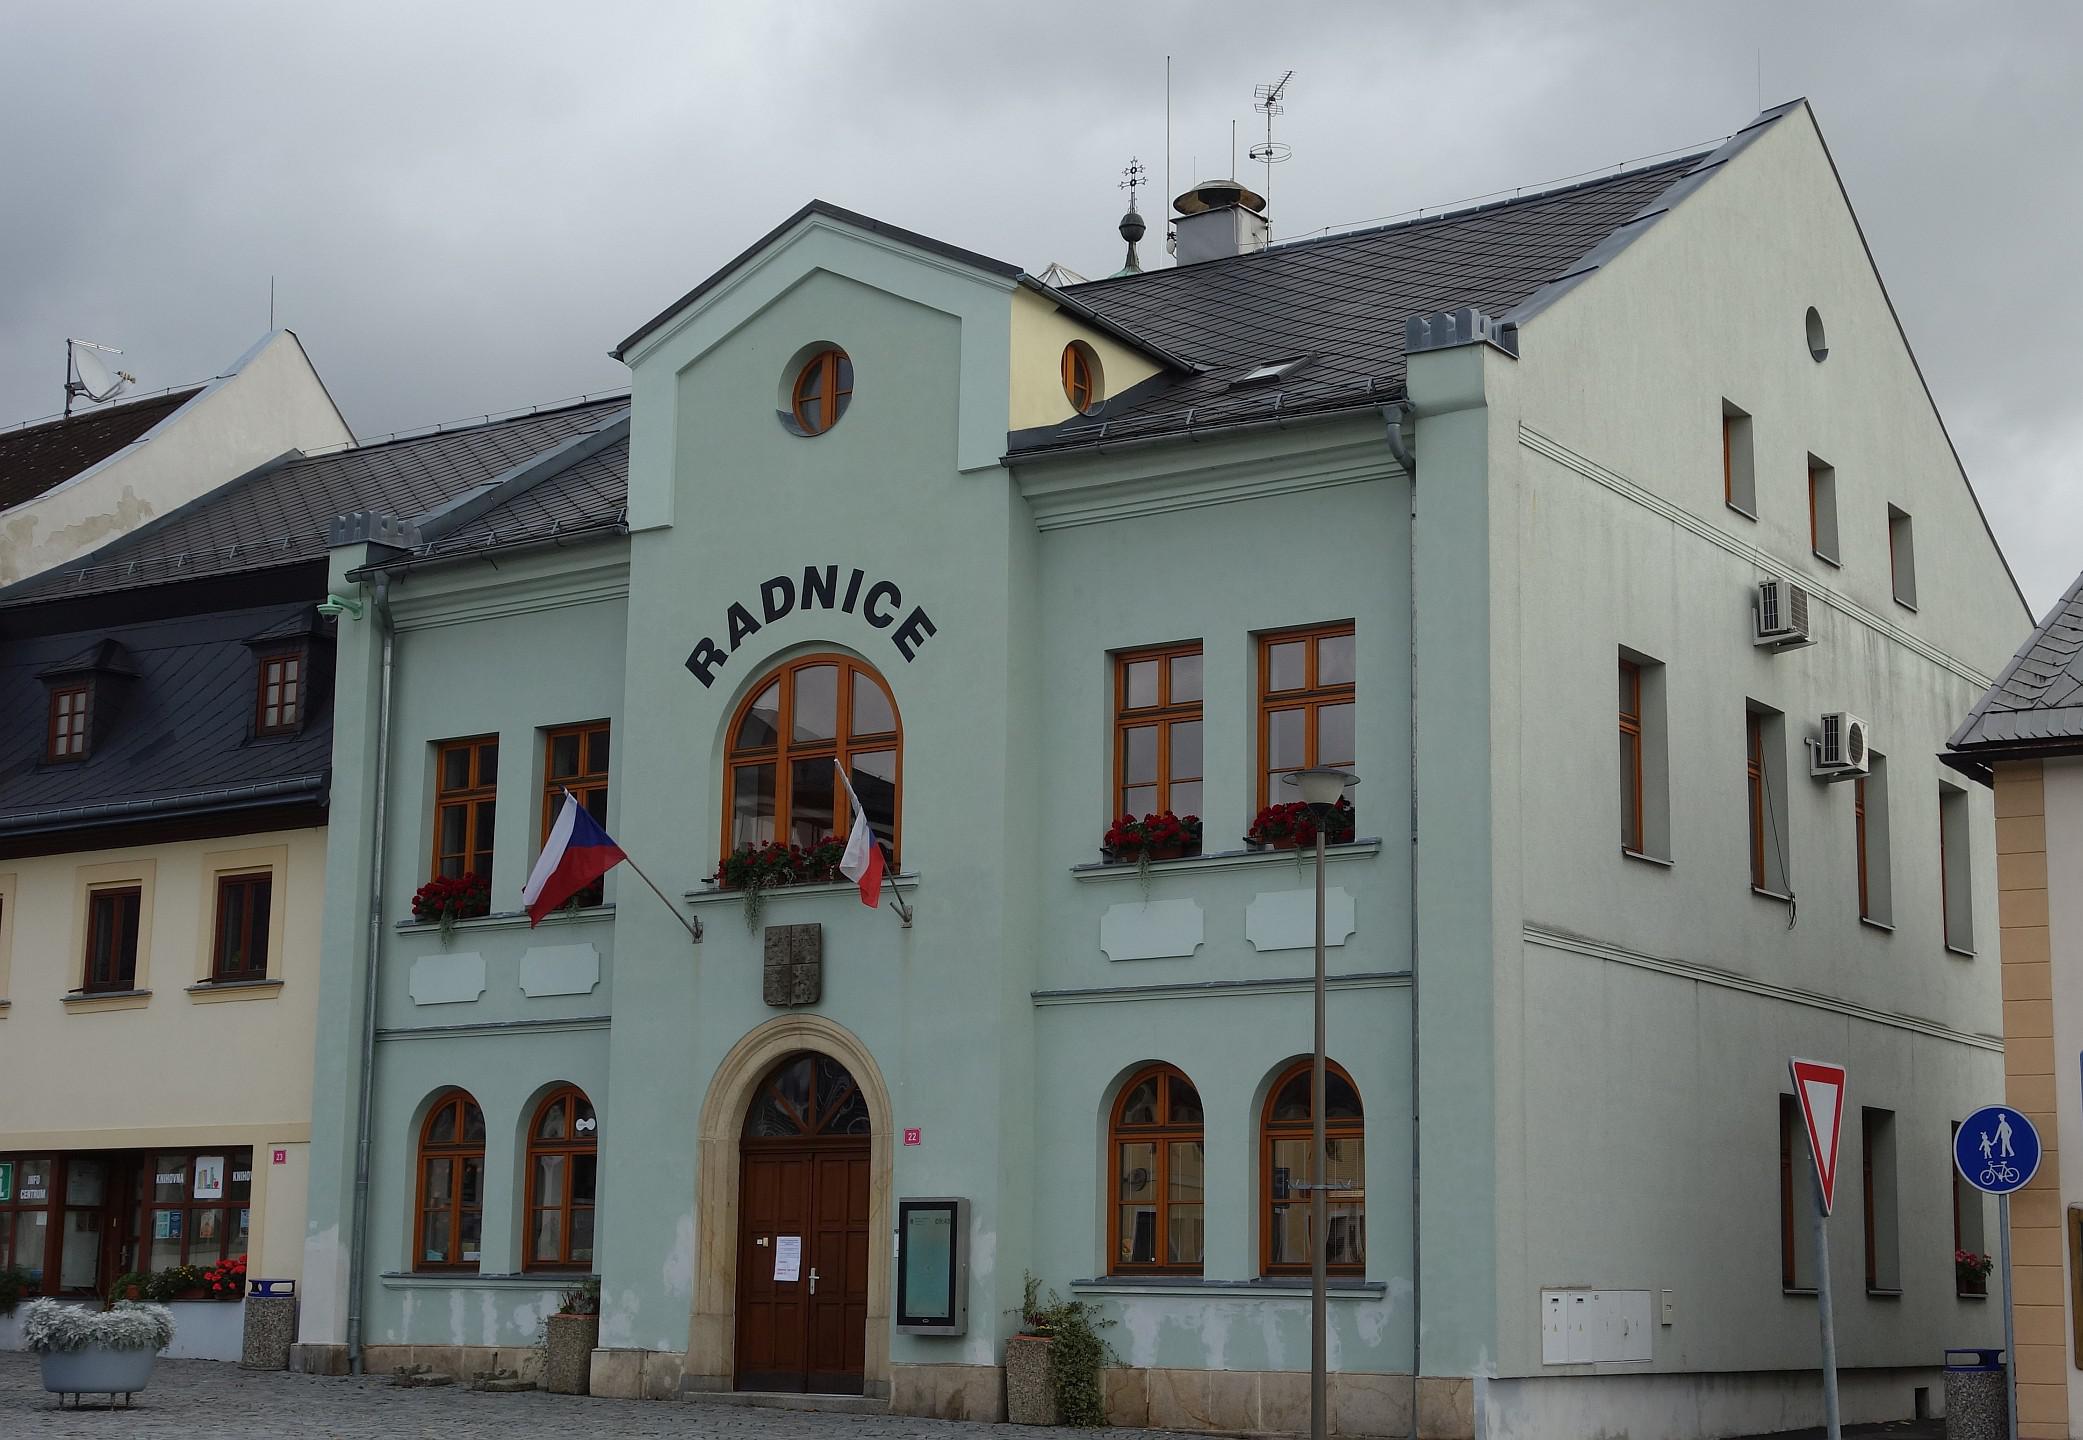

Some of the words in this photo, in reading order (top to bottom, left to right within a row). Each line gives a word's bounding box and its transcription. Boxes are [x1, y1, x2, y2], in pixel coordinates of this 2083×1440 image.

[685, 565, 938, 689] RADNICE
[27, 1175, 41, 1185] INFO
[156, 1173, 184, 1184] KNIHOVNA
[232, 1171, 252, 1182] KNIHO
[20, 1189, 46, 1199] CENTRUM
